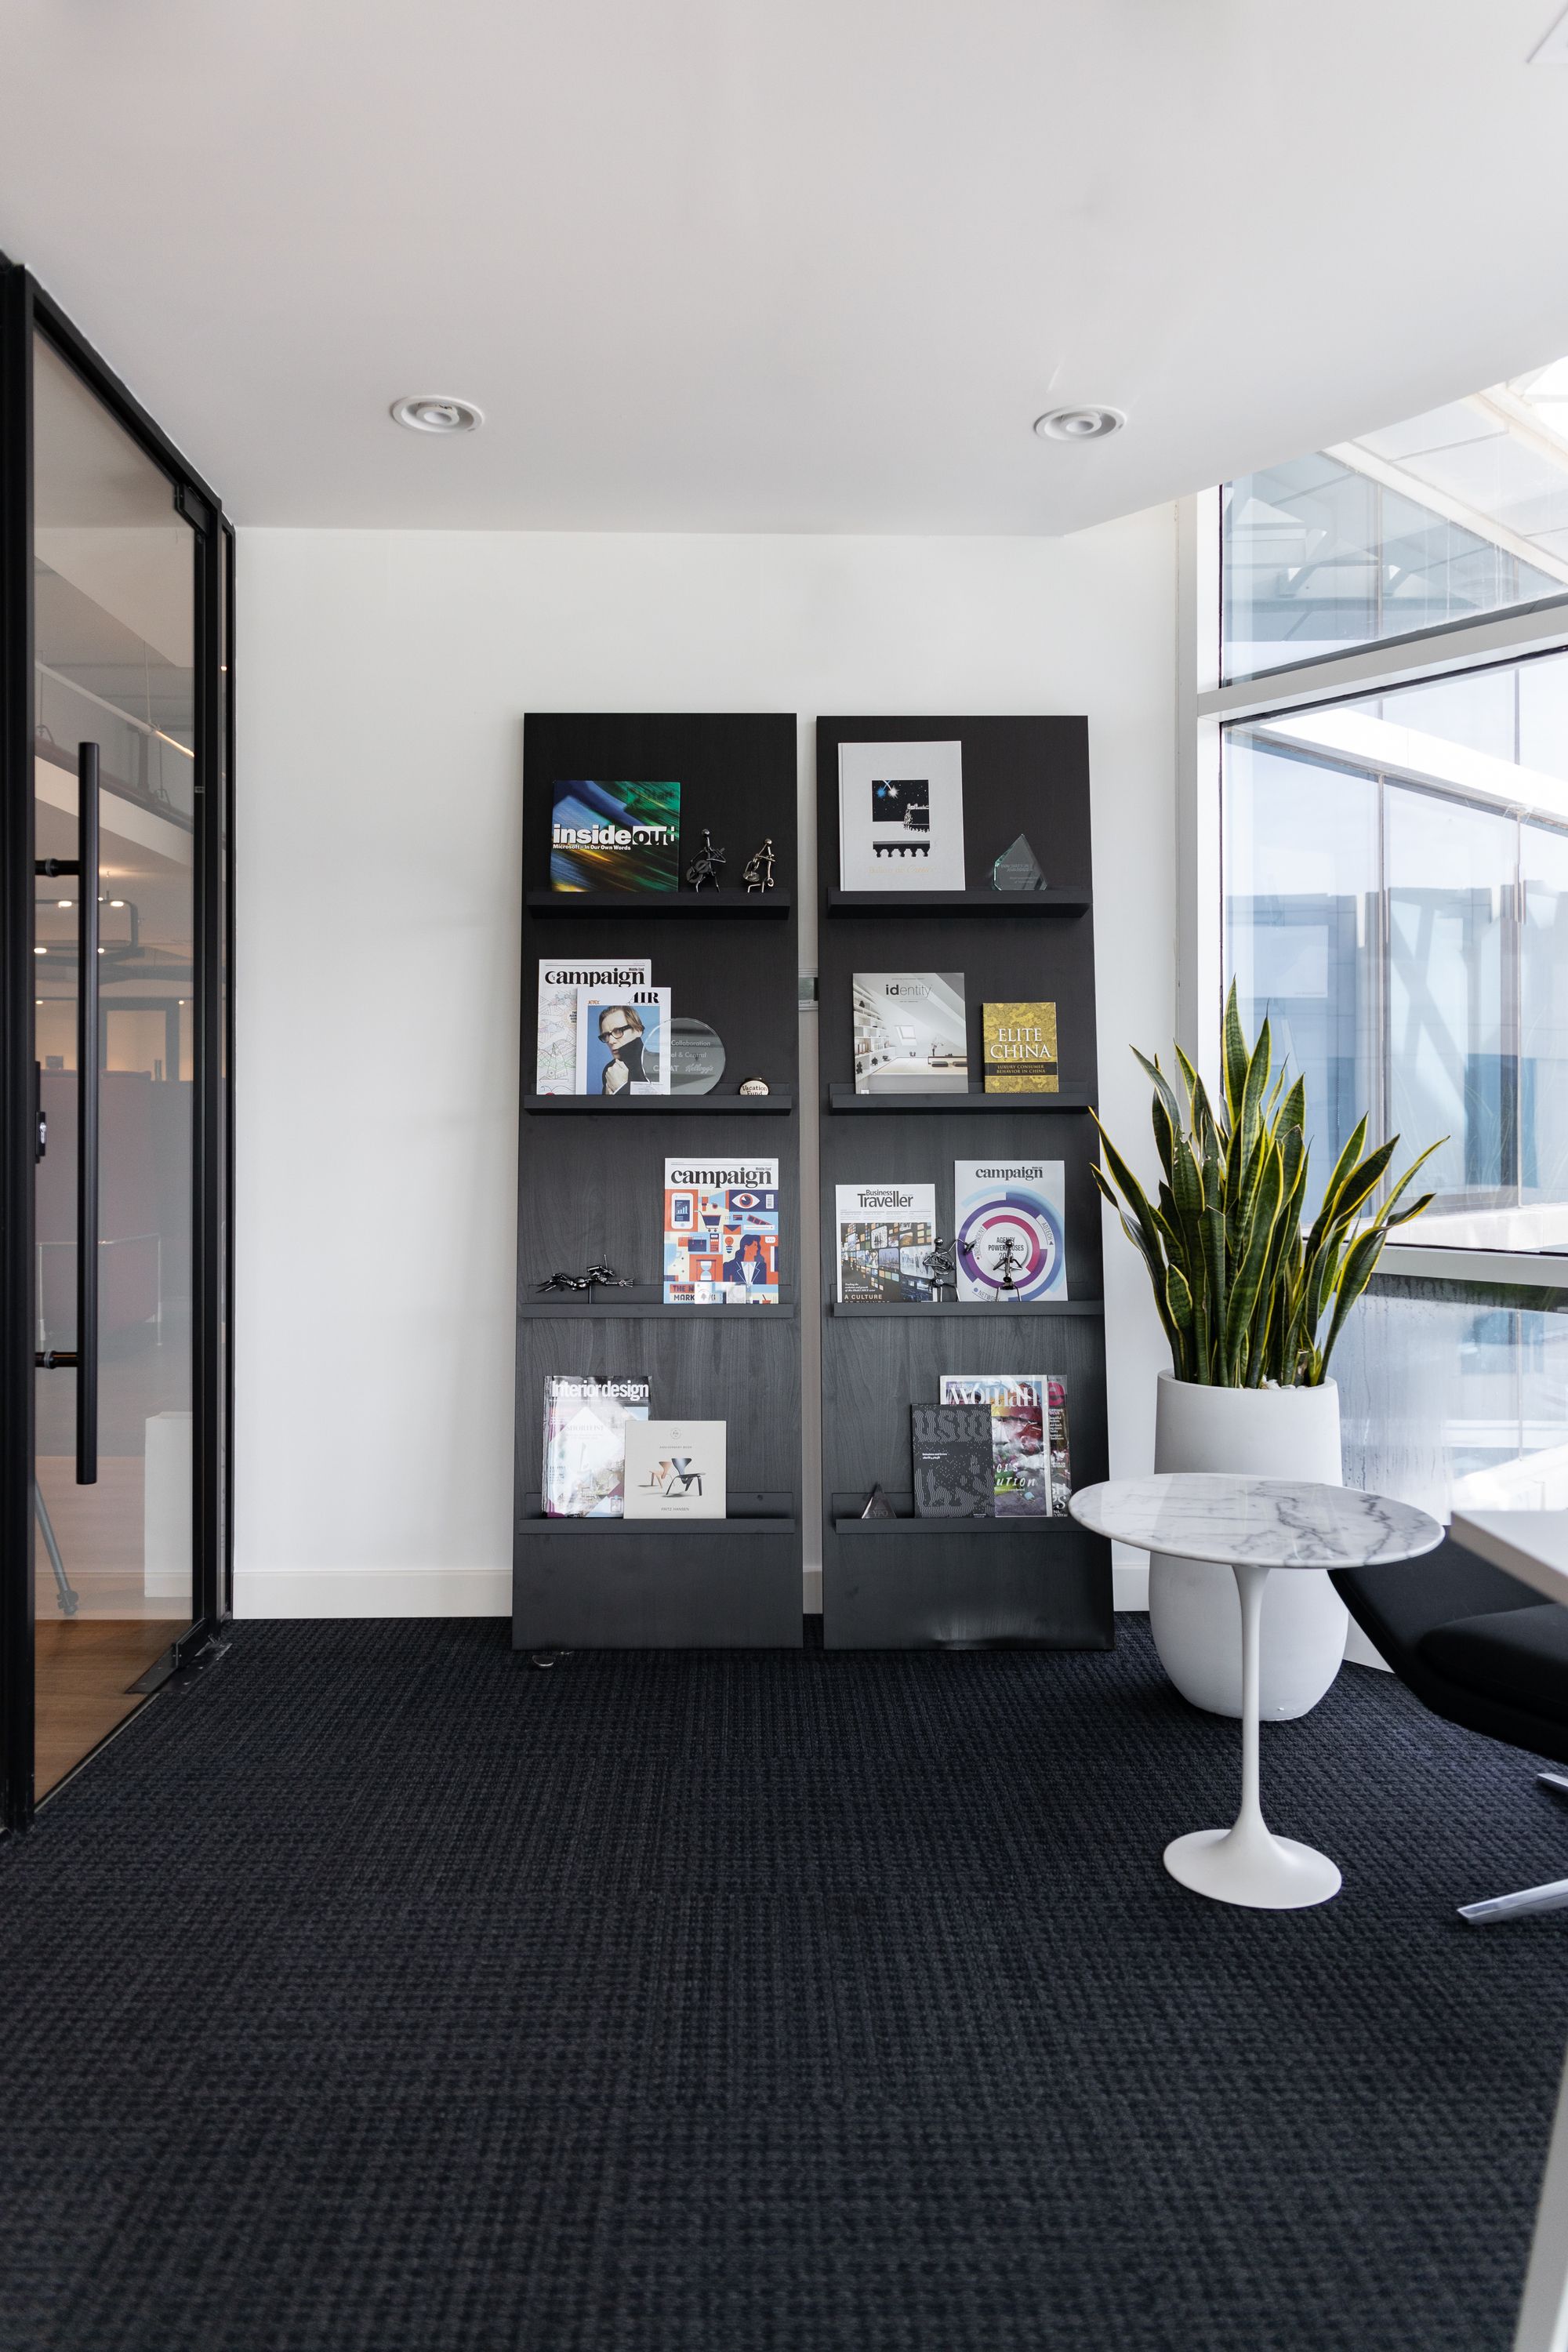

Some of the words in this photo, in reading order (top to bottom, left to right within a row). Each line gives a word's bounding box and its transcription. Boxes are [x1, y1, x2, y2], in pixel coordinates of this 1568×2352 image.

[545, 967, 644, 987] campaign
[628, 992, 659, 1004] AIR
[885, 984, 931, 998] identity
[998, 1028, 1043, 1042] ELITE
[990, 1044, 1053, 1058] CHINA
[670, 1167, 772, 1189] campaign
[975, 1167, 1043, 1181] campaign
[857, 1190, 914, 1208] Traveller
[1041, 1221, 1054, 1242] ADTECH
[950, 1386, 1039, 1407] woman
